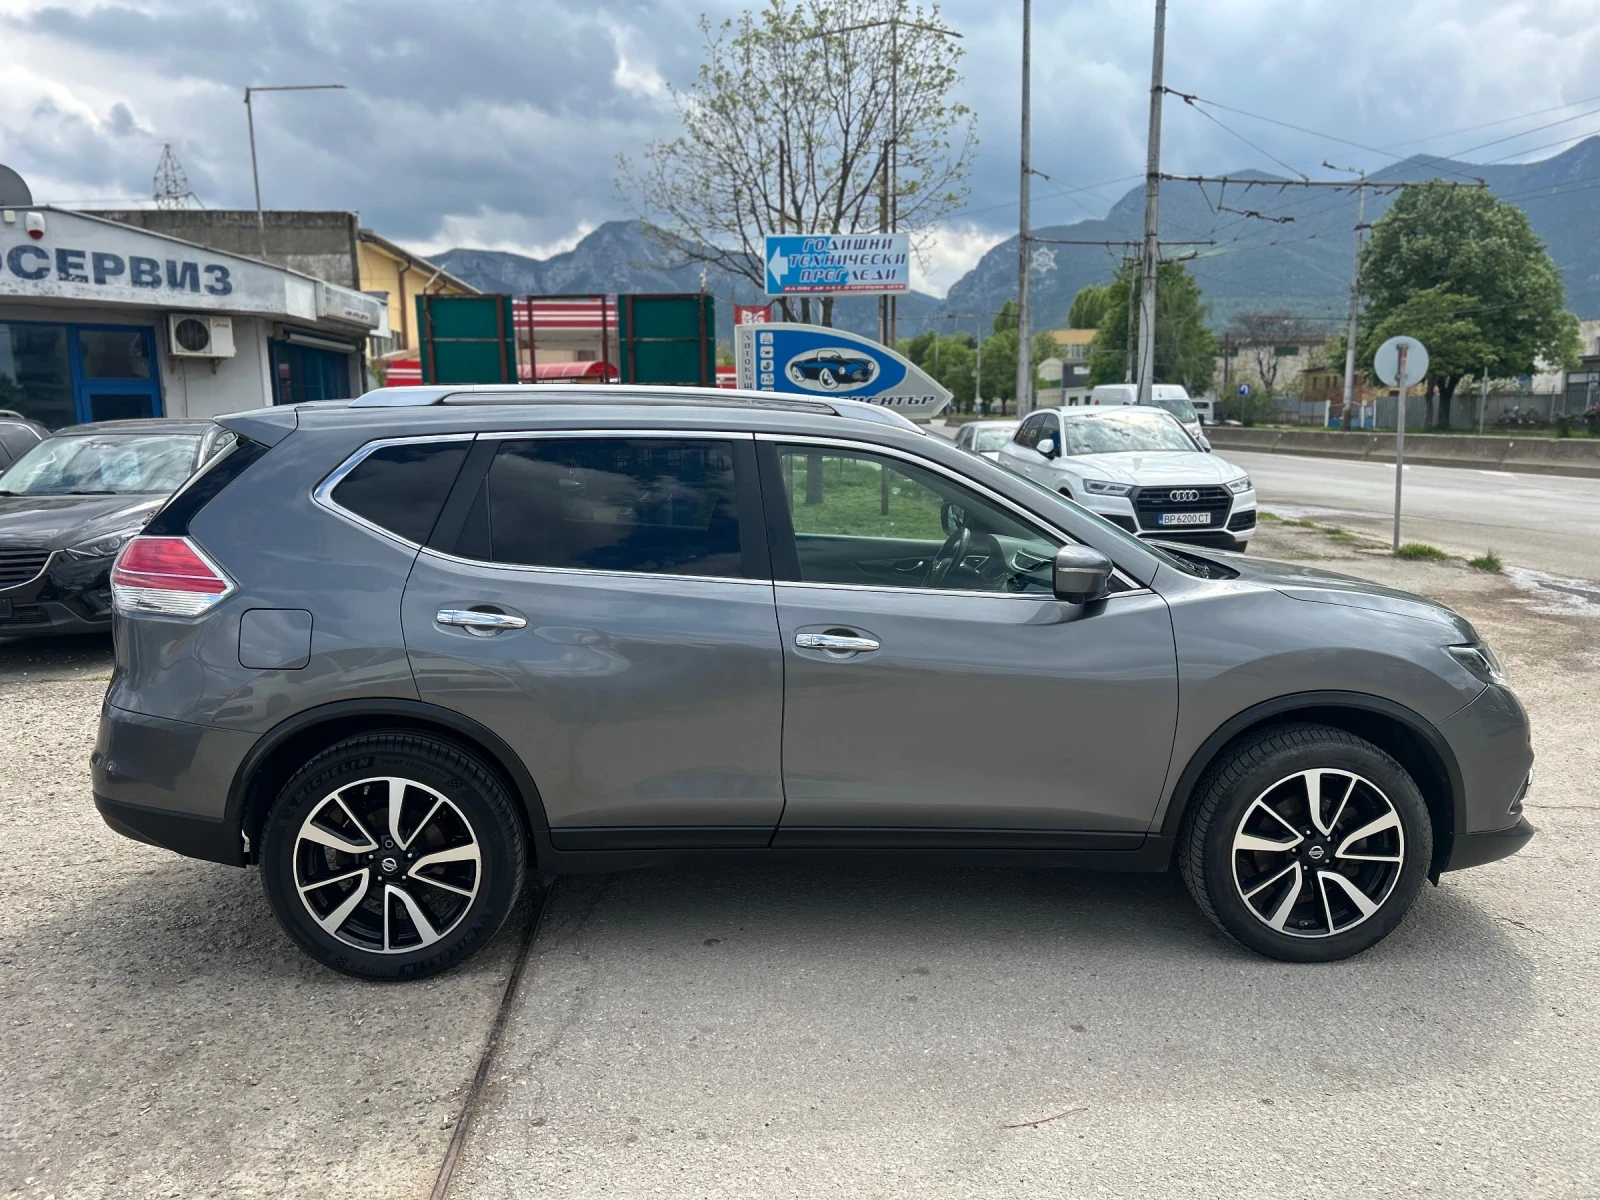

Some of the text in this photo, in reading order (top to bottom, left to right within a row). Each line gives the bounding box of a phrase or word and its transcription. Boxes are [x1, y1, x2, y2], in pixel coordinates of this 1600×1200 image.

[802, 237, 893, 252] ГОДИШНИ
[789, 252, 906, 268] ТЕХНИЧЕСКИ
[0, 244, 233, 296] СЕРВИЗ
[1164, 513, 1210, 524] BP 6200 CT
[294, 757, 370, 804] MICHELIN
